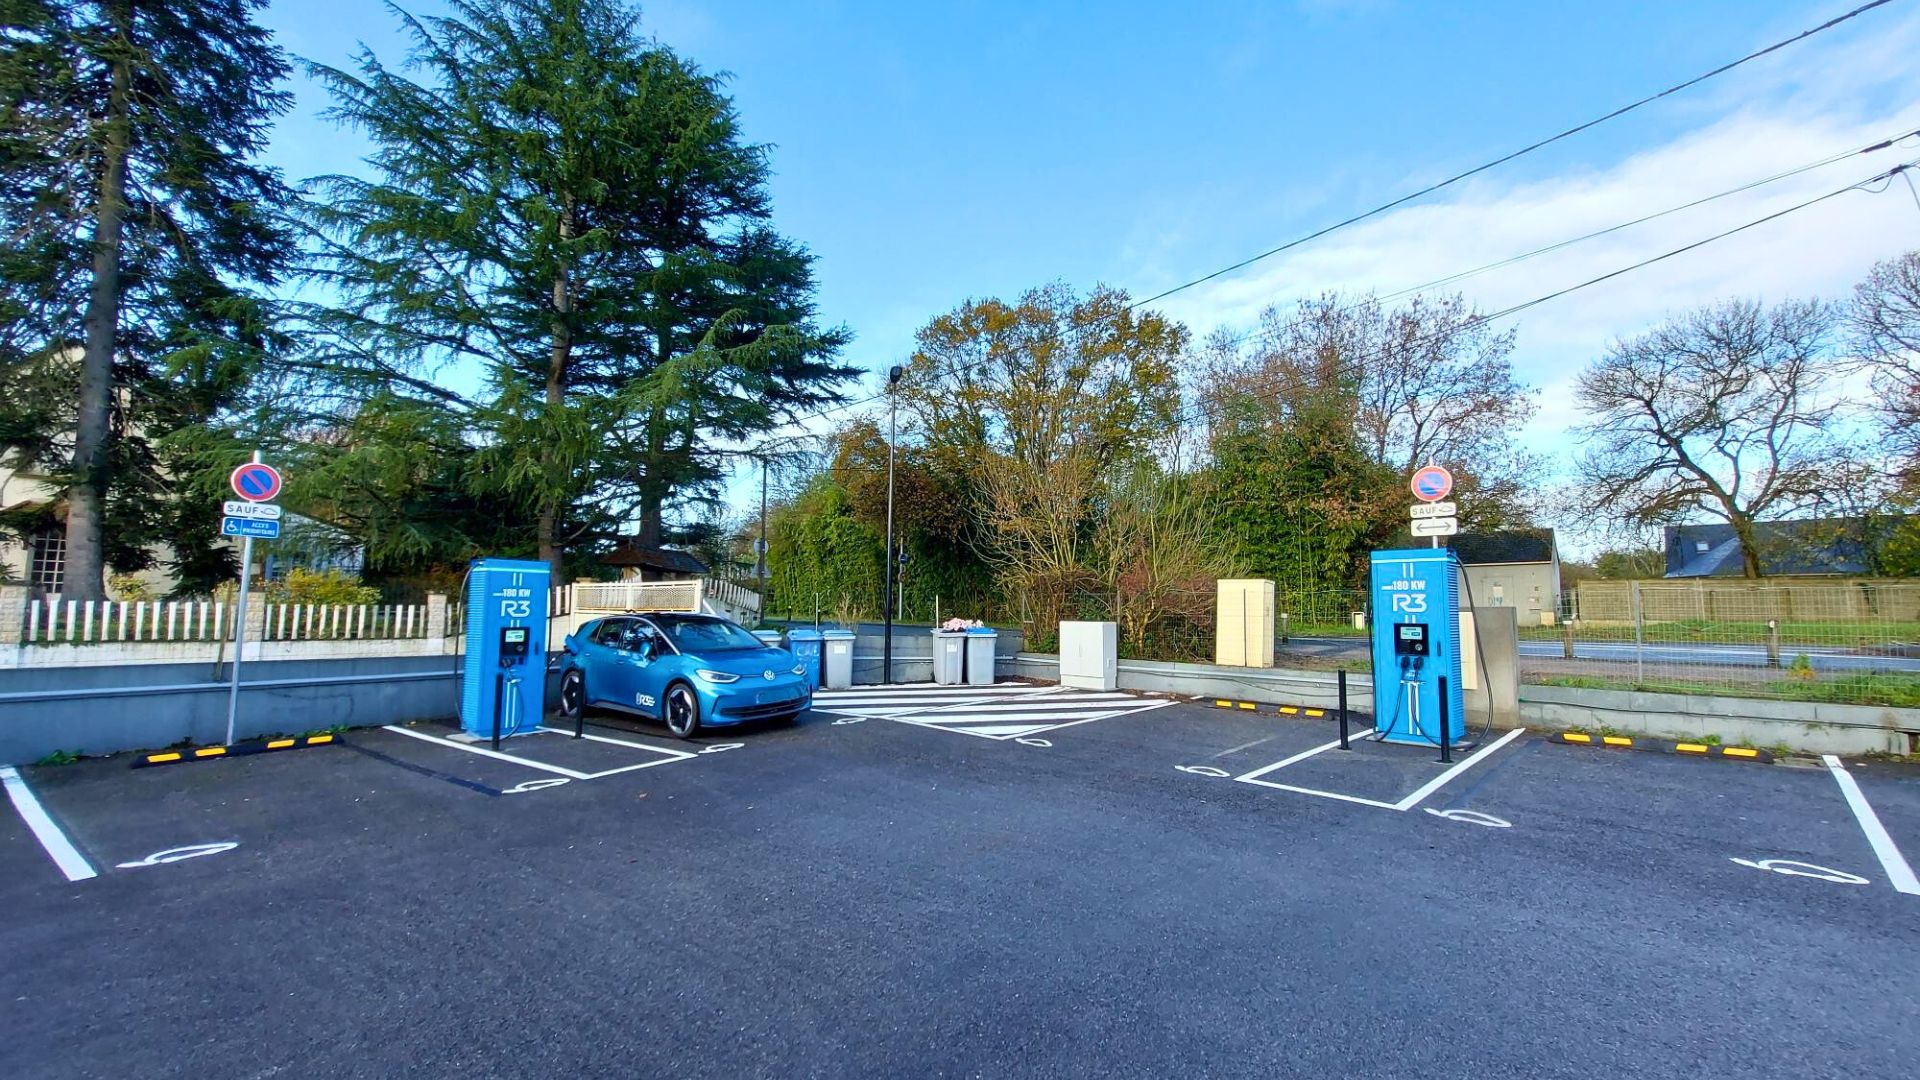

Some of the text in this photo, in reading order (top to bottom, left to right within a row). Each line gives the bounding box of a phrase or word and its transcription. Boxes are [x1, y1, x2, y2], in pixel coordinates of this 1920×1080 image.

[227, 504, 258, 514] SAUF
[1412, 506, 1437, 515] SAUF
[1392, 579, 1426, 590] 180 KW
[503, 588, 531, 598] 180 KW
[1392, 593, 1427, 613] R3
[501, 600, 531, 618] R3
